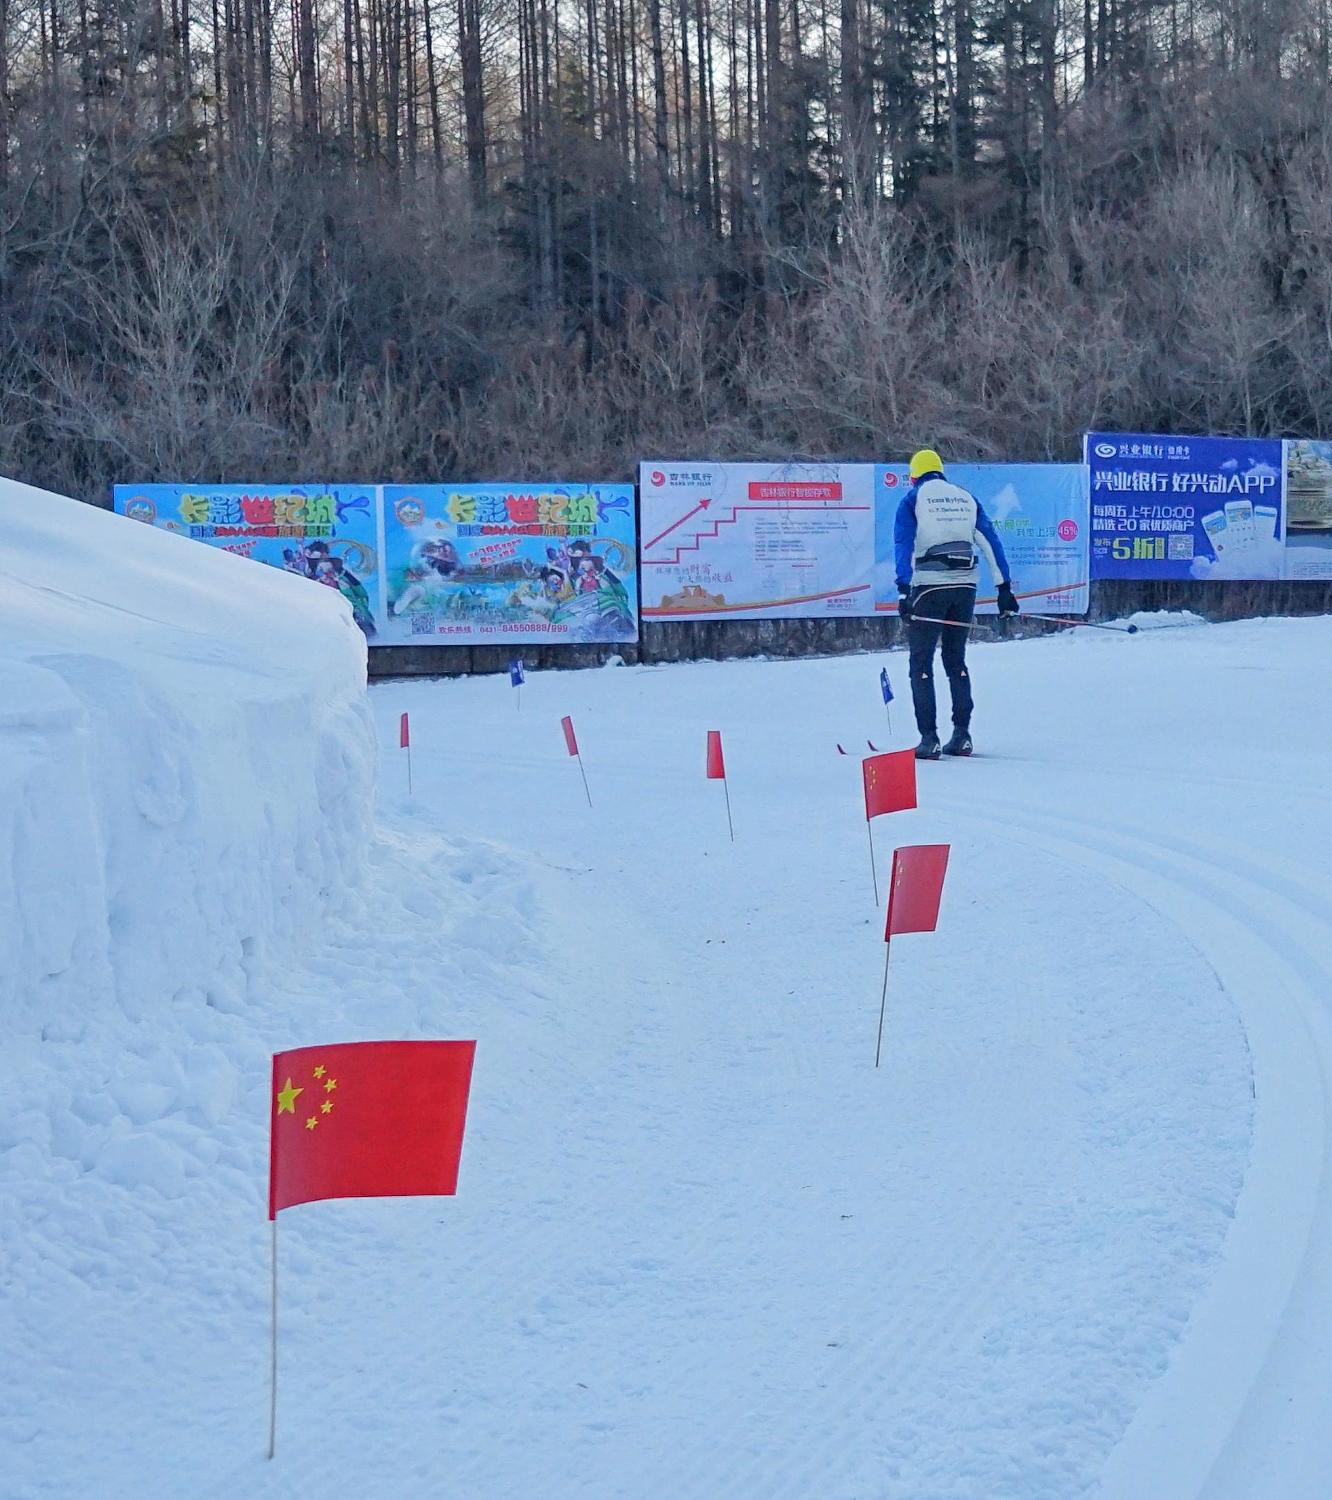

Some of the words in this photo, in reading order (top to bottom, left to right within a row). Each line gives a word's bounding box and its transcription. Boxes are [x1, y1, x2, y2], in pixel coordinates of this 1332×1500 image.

[1120, 445, 1163, 455] 兴业银行
[669, 473, 712, 481] 吉林银行
[1095, 471, 1169, 492] 兴业银行
[1172, 473, 1275, 494] 好兴动APP
[178, 494, 338, 524] 长影世纪城
[446, 493, 598, 524] 长影世纪城
[1093, 505, 1127, 518] 每周五
[1128, 505, 1195, 519] 上午/10:00
[1059, 526, 1078, 536] 45%
[1093, 519, 1116, 531] 精选
[1117, 519, 1137, 531] 20
[1139, 519, 1195, 532] 家优质商户
